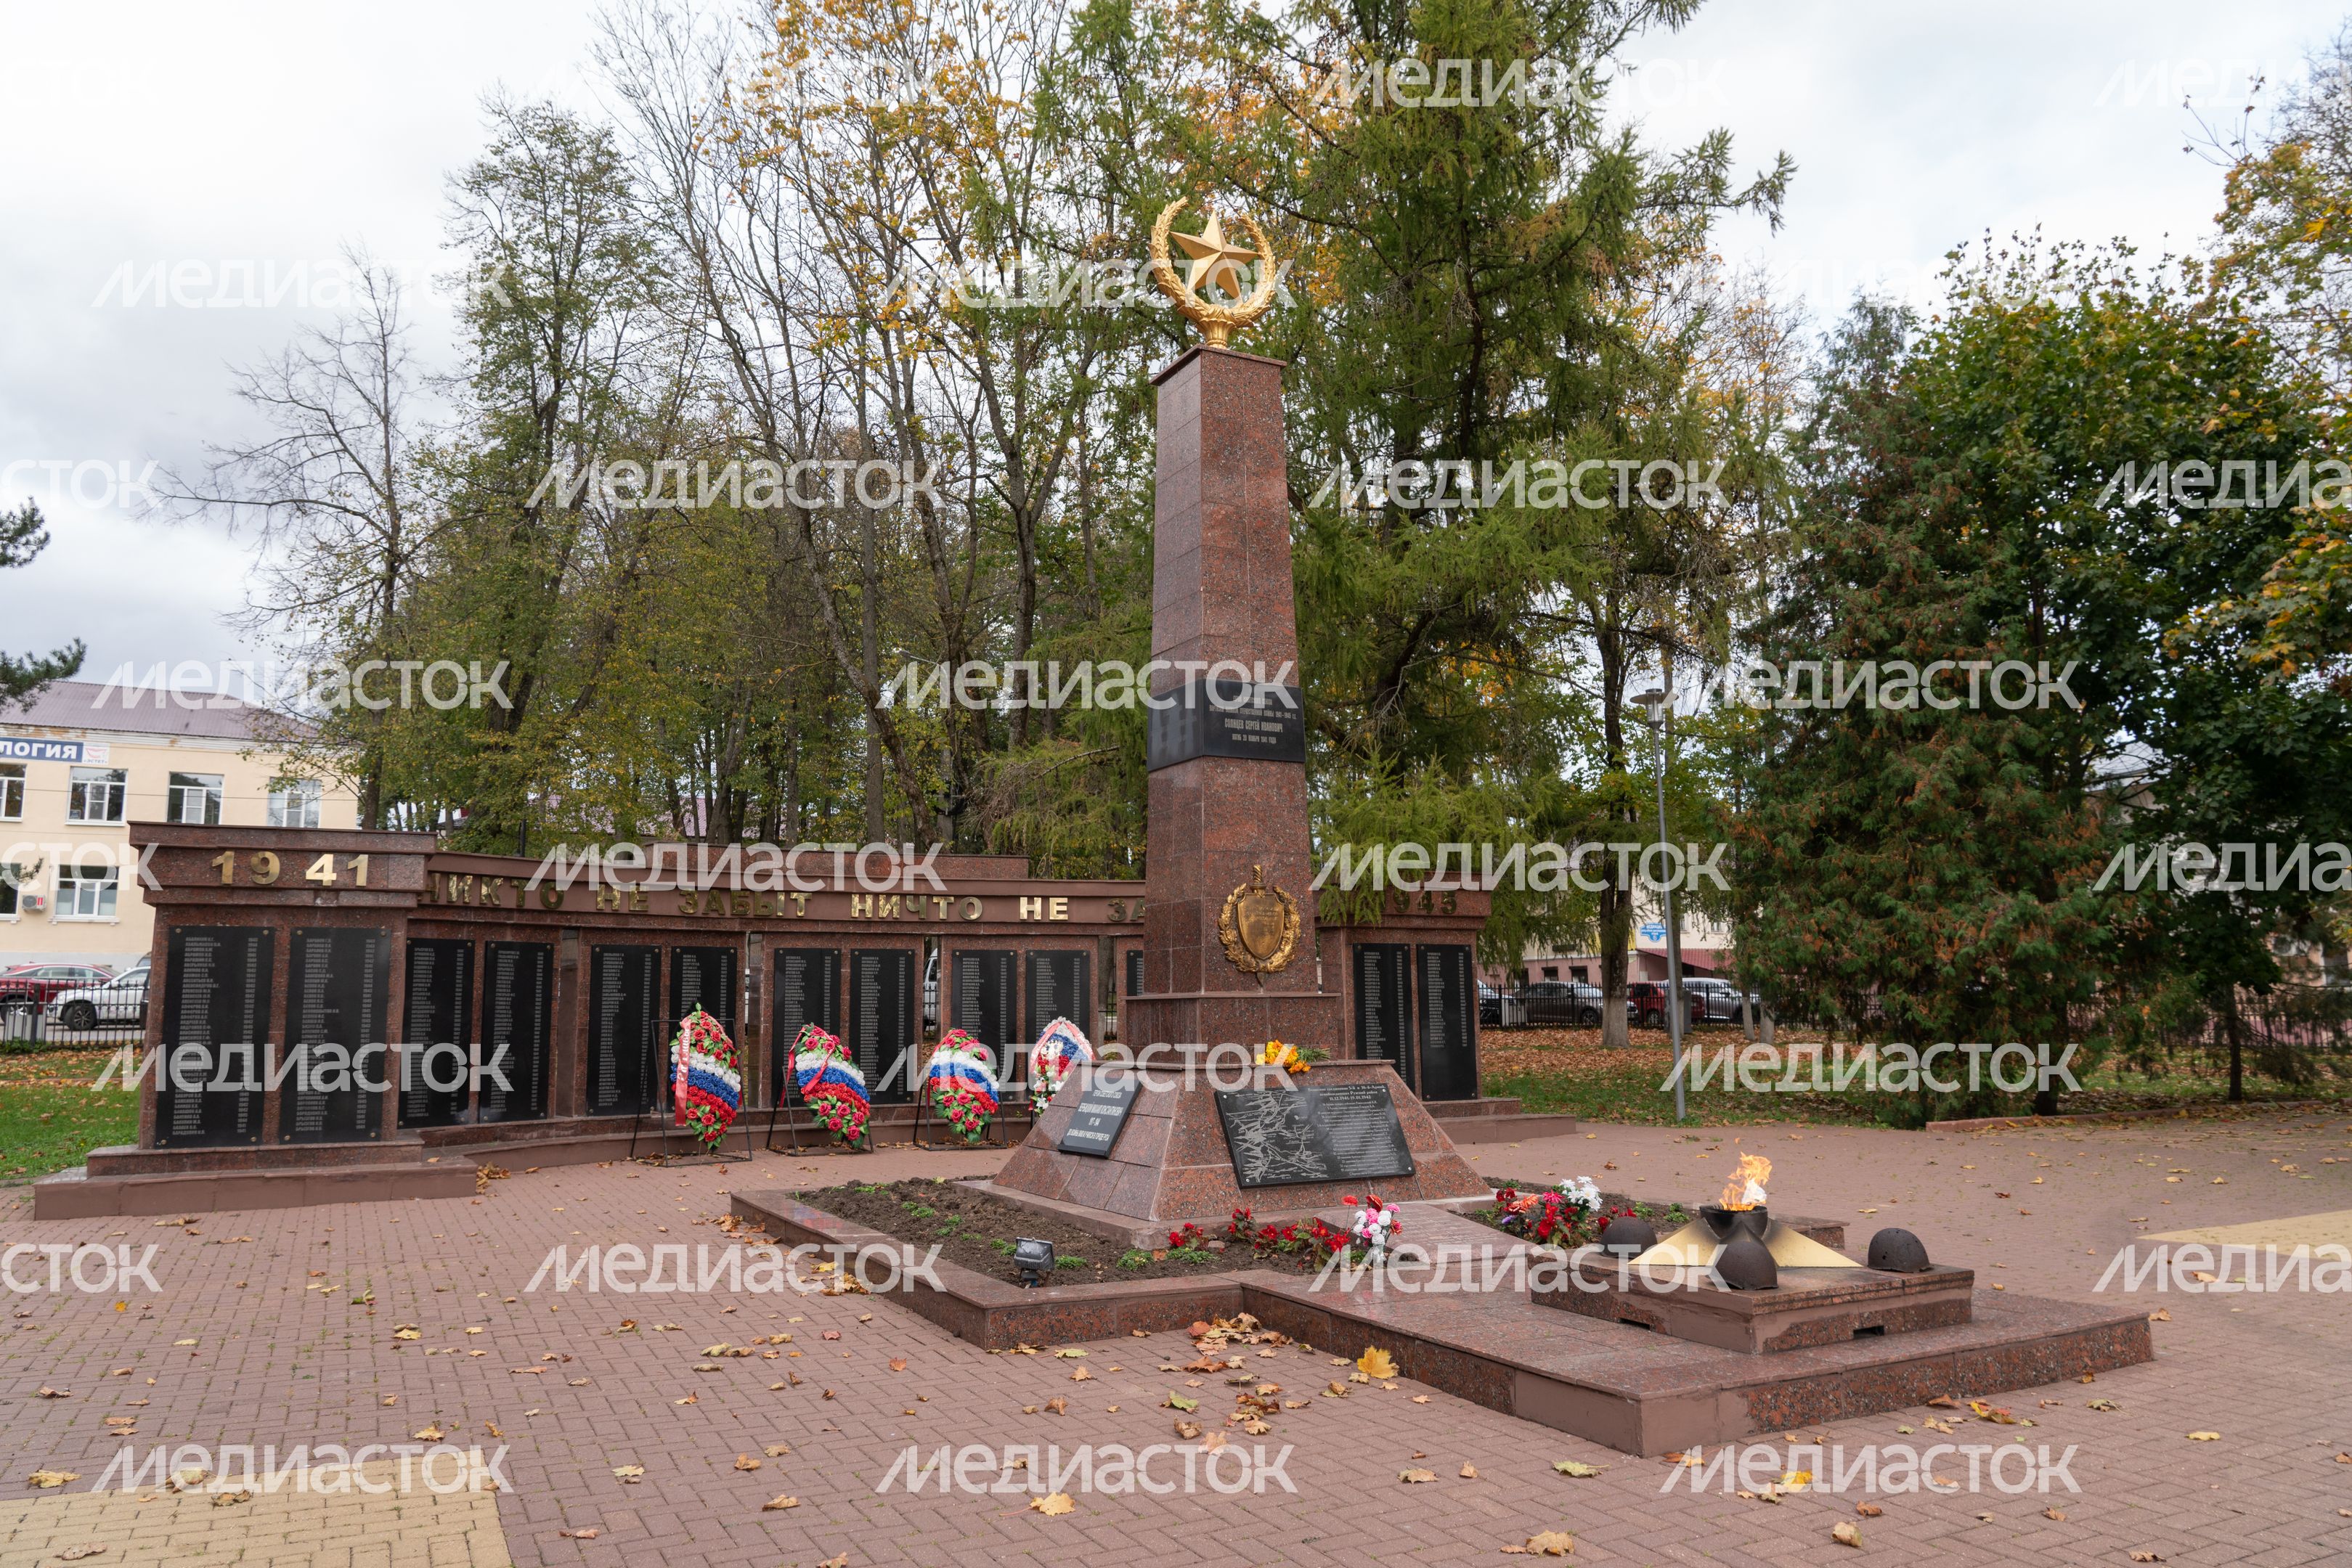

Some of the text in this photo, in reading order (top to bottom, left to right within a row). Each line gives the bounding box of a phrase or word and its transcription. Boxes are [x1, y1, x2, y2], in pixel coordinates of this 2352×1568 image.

[1224, 718, 1283, 732] СОЛНЦЕВ СЕРГЕЙ ИВАНОВИЧ
[596, 883, 648, 912] НЕ
[678, 889, 813, 917] ЗАБЫТ
[851, 894, 982, 920] НИЧТО
[1020, 897, 1069, 920] НЕ
[1378, 888, 1457, 915] 945
